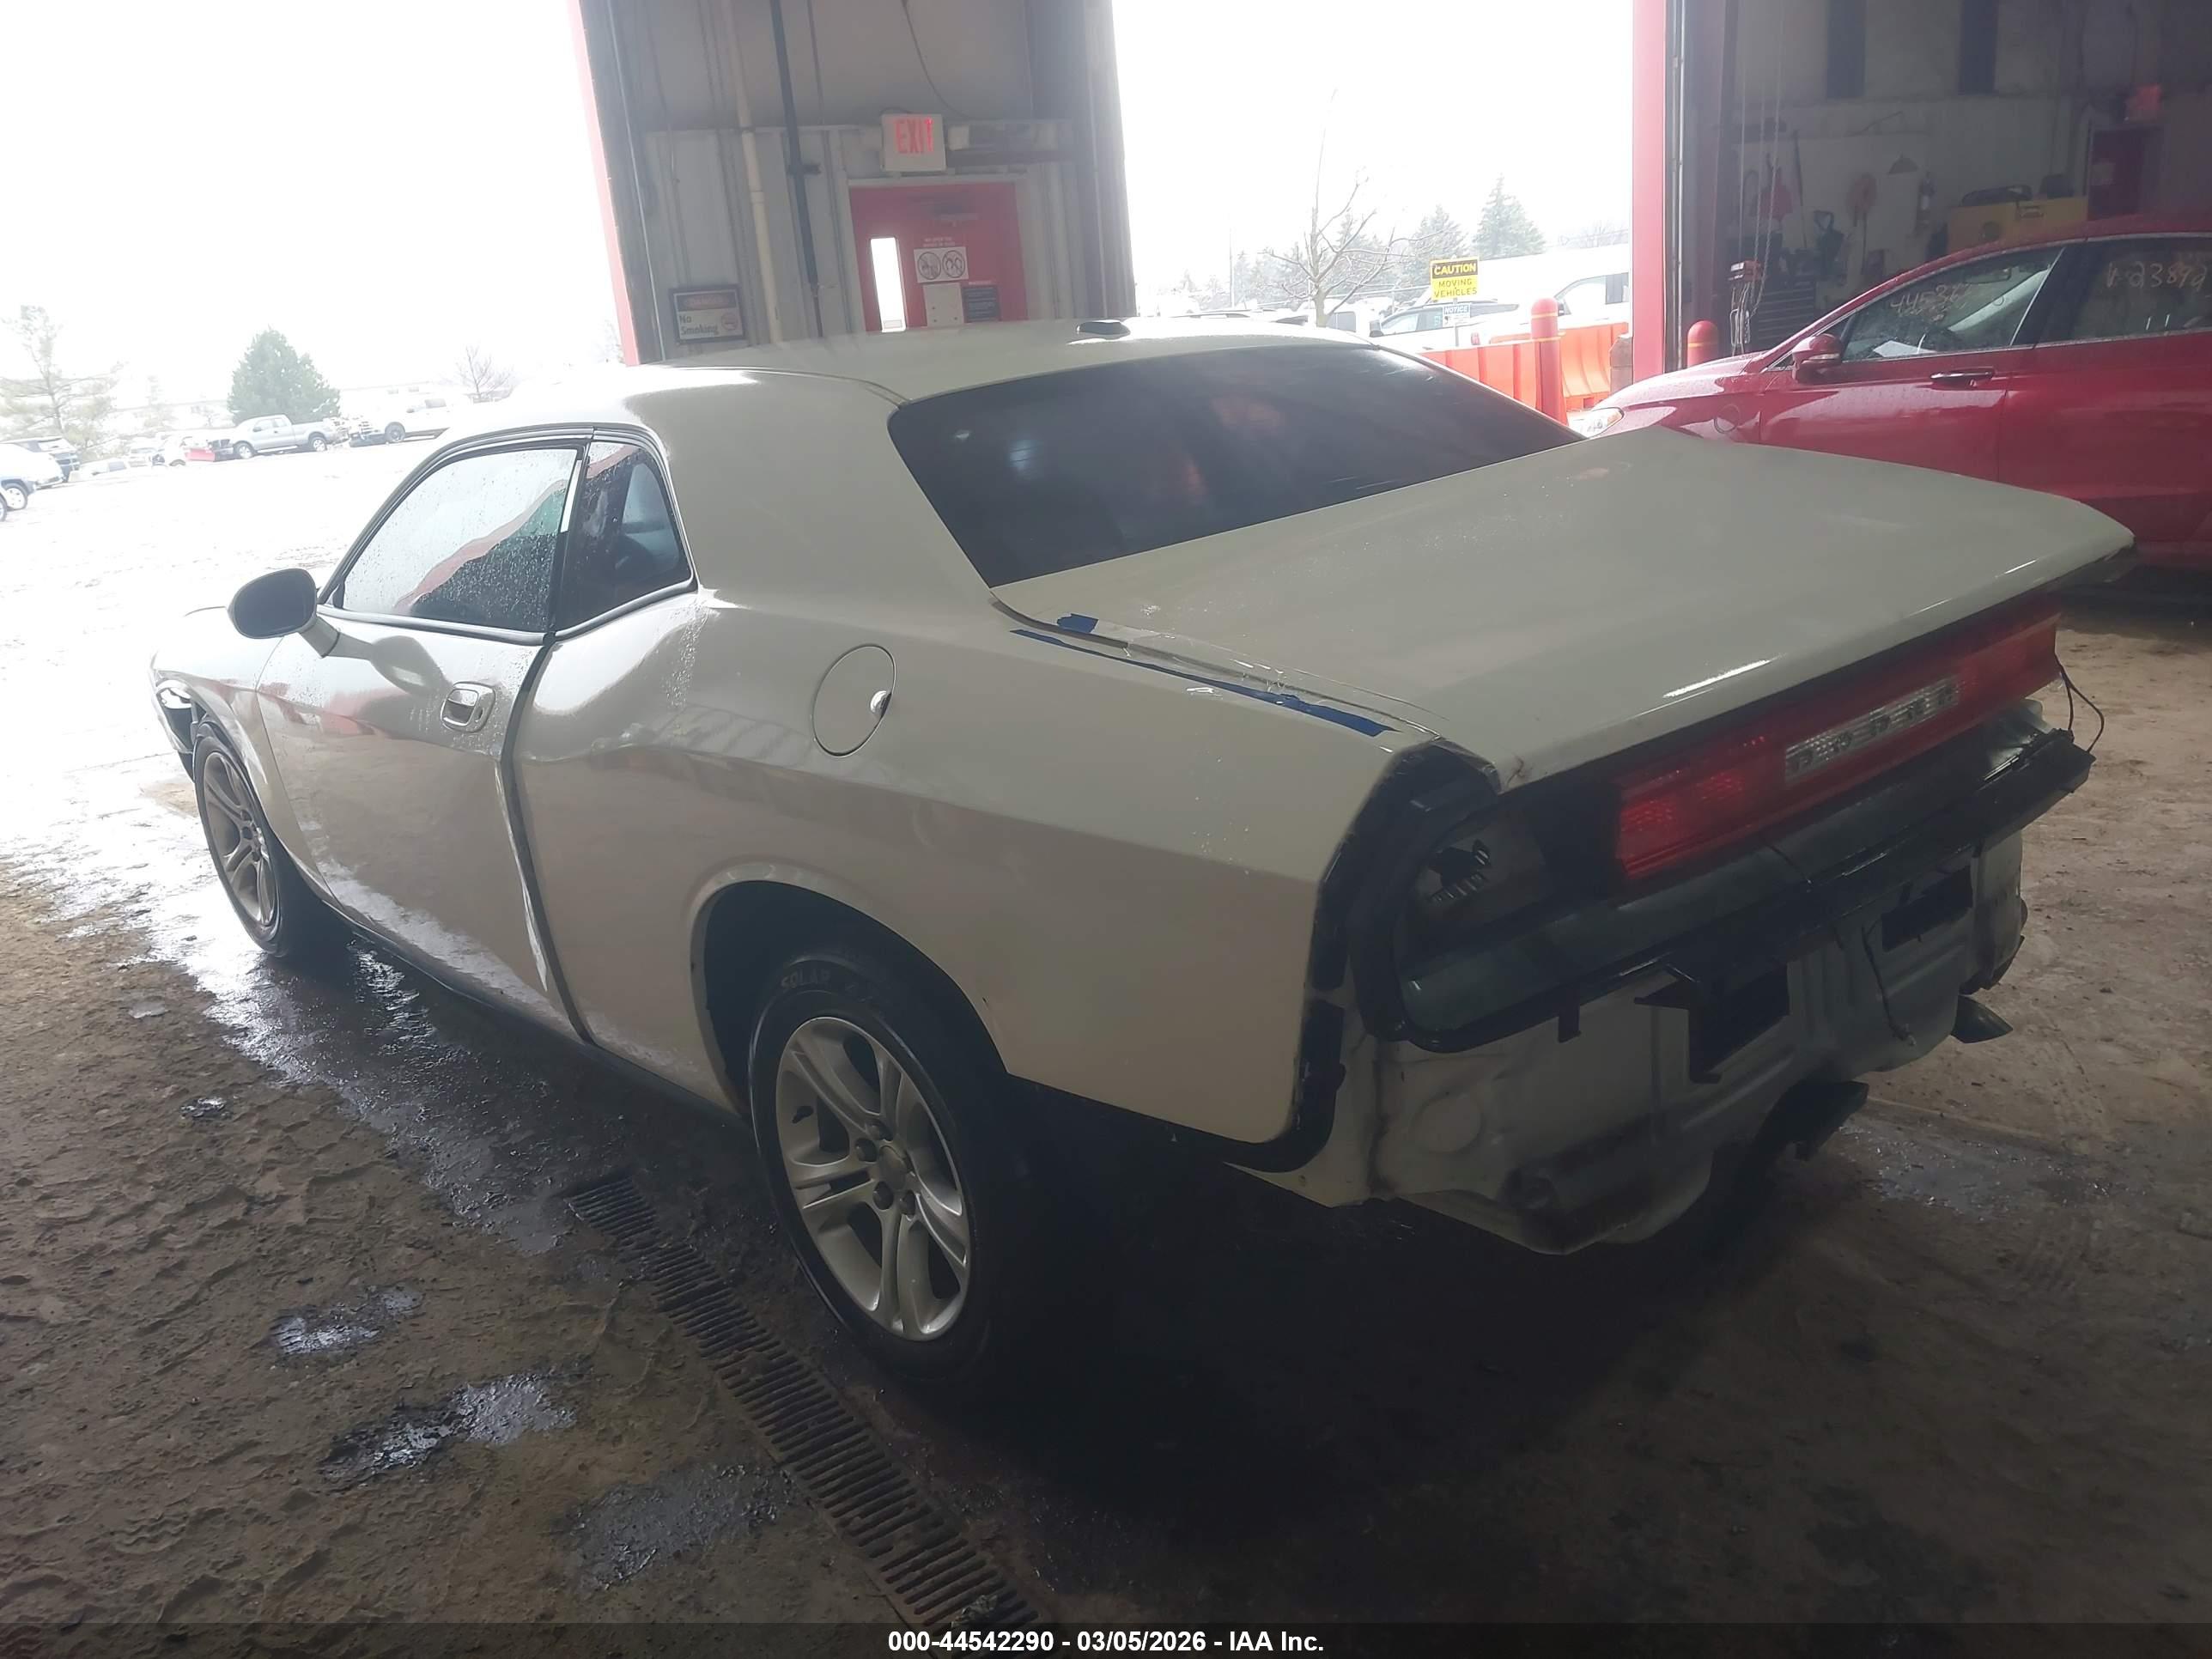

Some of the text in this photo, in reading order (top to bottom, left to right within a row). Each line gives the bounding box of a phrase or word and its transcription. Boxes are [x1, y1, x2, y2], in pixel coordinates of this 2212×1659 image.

[895, 118, 933, 153] EXIT
[1433, 263, 1476, 275] CAUTION
[1438, 278, 1472, 288] MOVING
[1434, 287, 1477, 298] VEHICLES
[1444, 305, 1468, 314] NOTICE
[679, 315, 692, 324] No
[681, 324, 720, 336] Smoking
